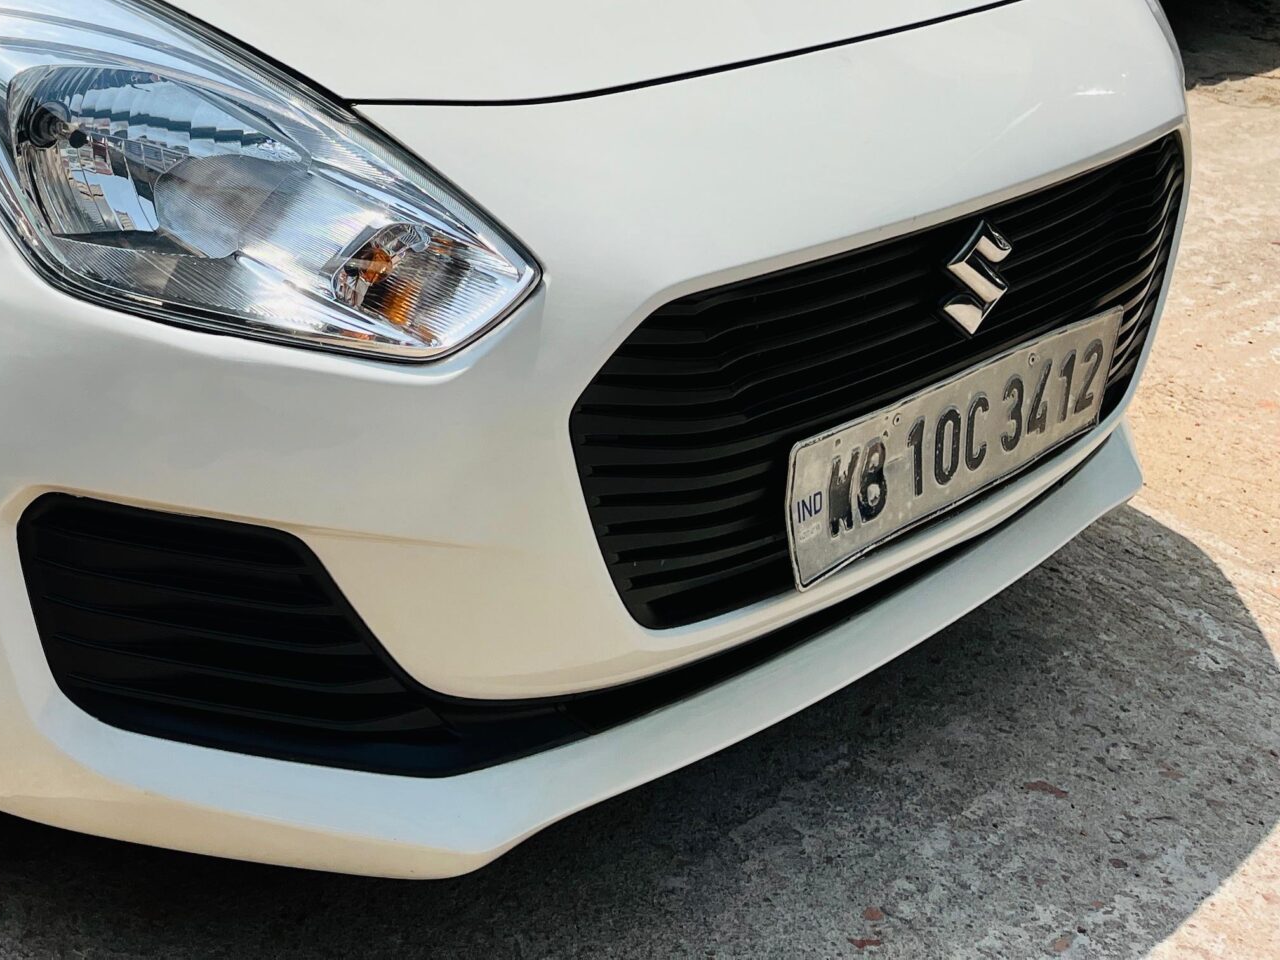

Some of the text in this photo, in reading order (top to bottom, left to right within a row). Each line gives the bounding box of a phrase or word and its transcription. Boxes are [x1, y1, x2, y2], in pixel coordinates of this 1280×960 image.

[907, 392, 989, 496] 10C
[1001, 338, 1104, 451] 3412
[797, 491, 822, 524] IND
